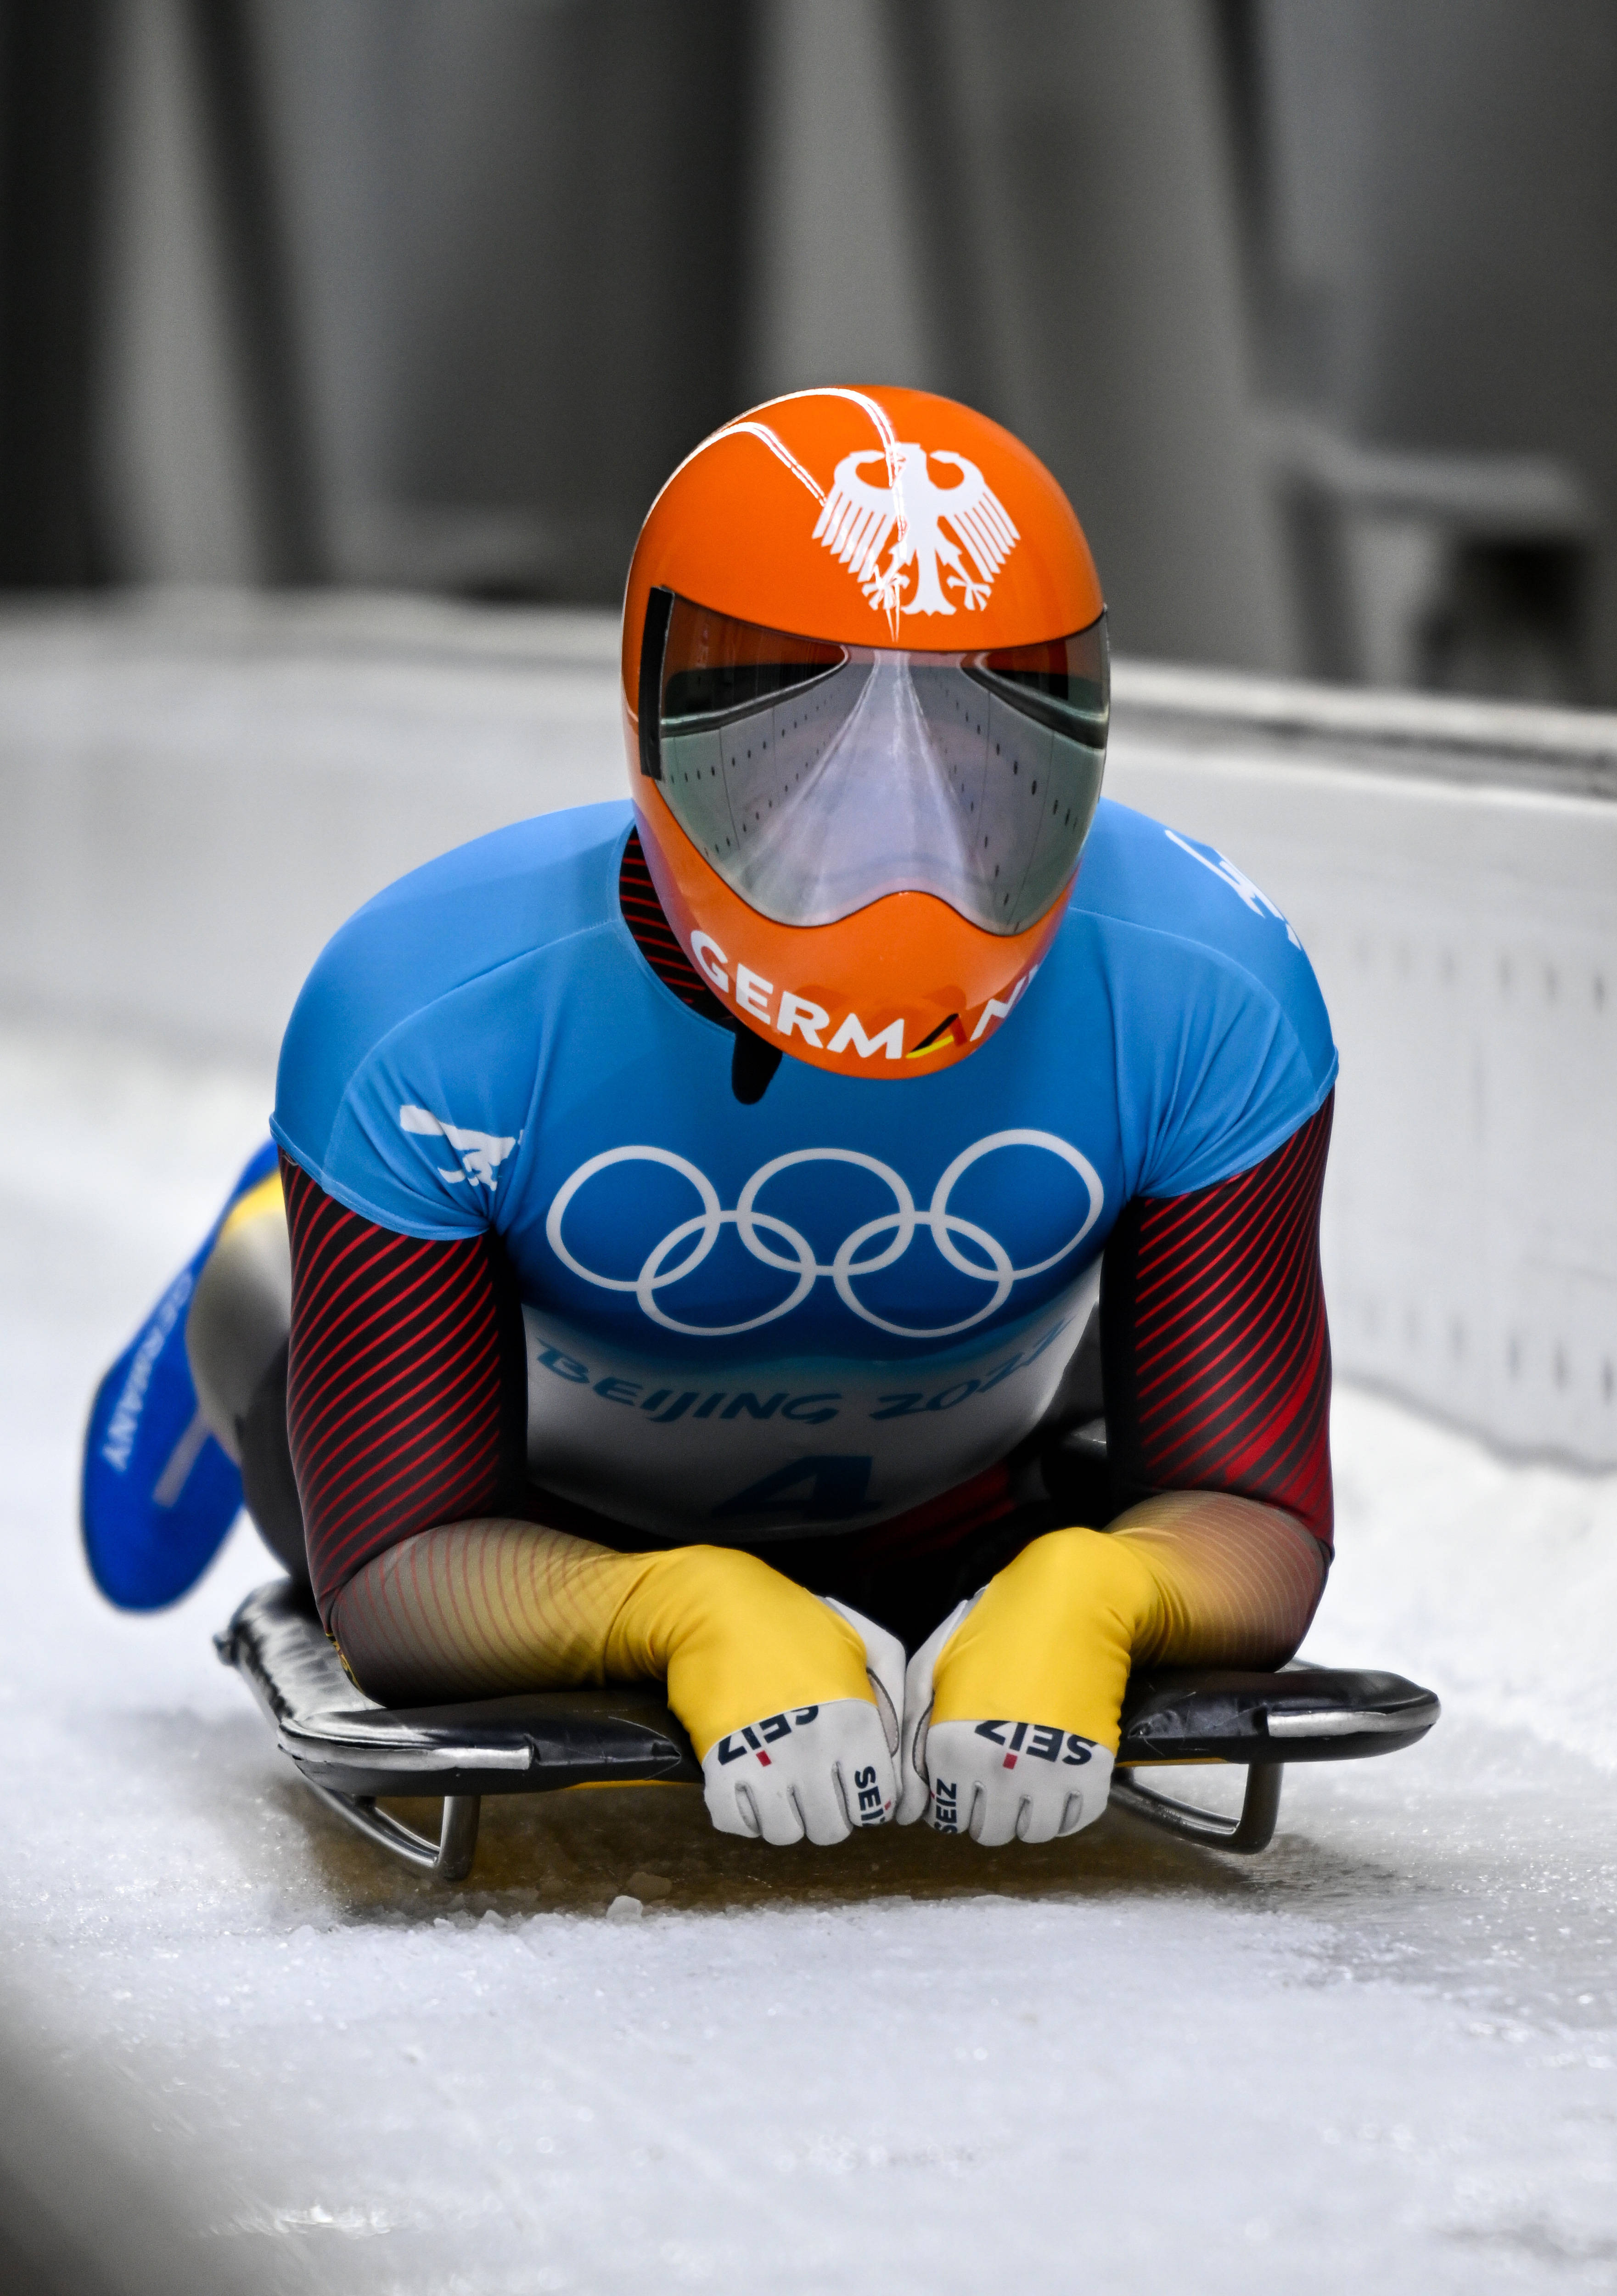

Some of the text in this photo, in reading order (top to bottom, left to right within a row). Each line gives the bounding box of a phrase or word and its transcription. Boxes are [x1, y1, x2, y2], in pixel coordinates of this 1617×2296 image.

[535, 1338, 842, 1424] BEIJING
[712, 1455, 881, 1519] 4
[854, 1766, 892, 1828] SEI
